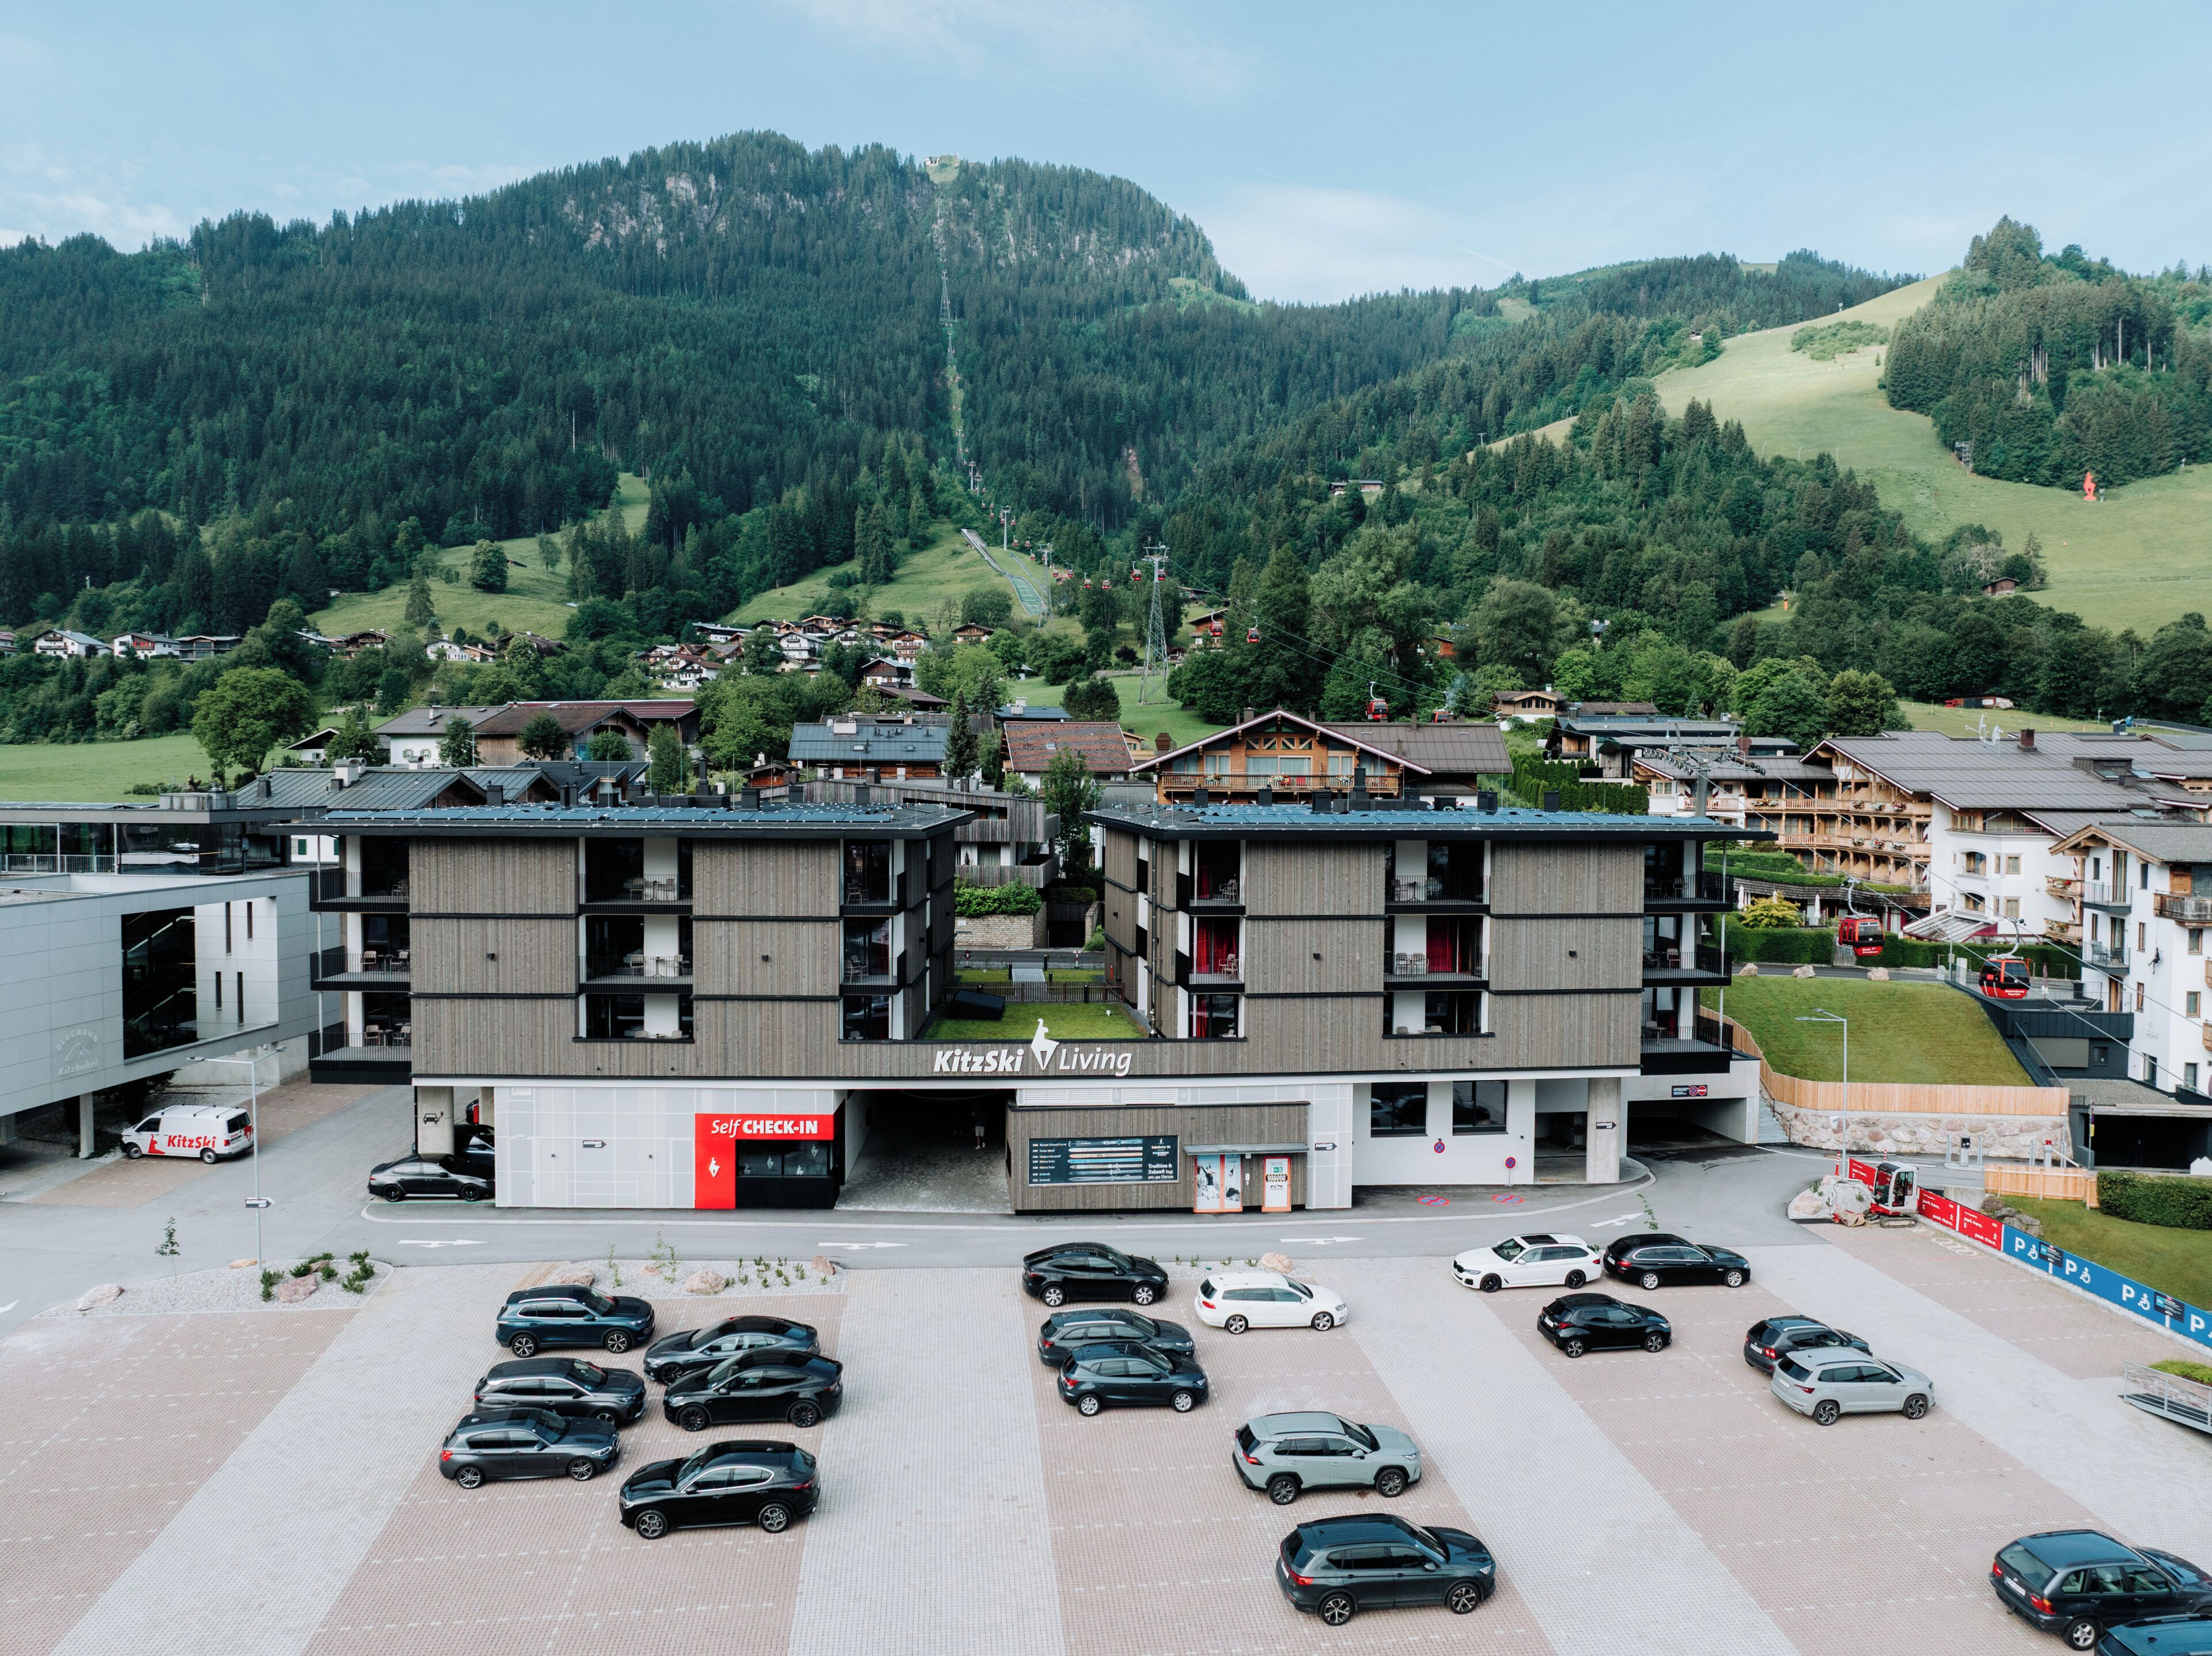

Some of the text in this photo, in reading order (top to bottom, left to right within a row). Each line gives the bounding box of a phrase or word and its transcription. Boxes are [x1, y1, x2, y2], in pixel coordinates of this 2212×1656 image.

[56, 1028, 99, 1051] BERGBAHN
[59, 1058, 98, 1076] Kitzbühel
[933, 1047, 1132, 1077] KitzSki Living
[711, 1119, 818, 1138] Self CHECK-IN
[167, 1135, 217, 1149] KitzSki
[2014, 1237, 2025, 1252] P
[2065, 1259, 2077, 1275] P
[2122, 1284, 2135, 1301] P
[2190, 1314, 2205, 1332] P
